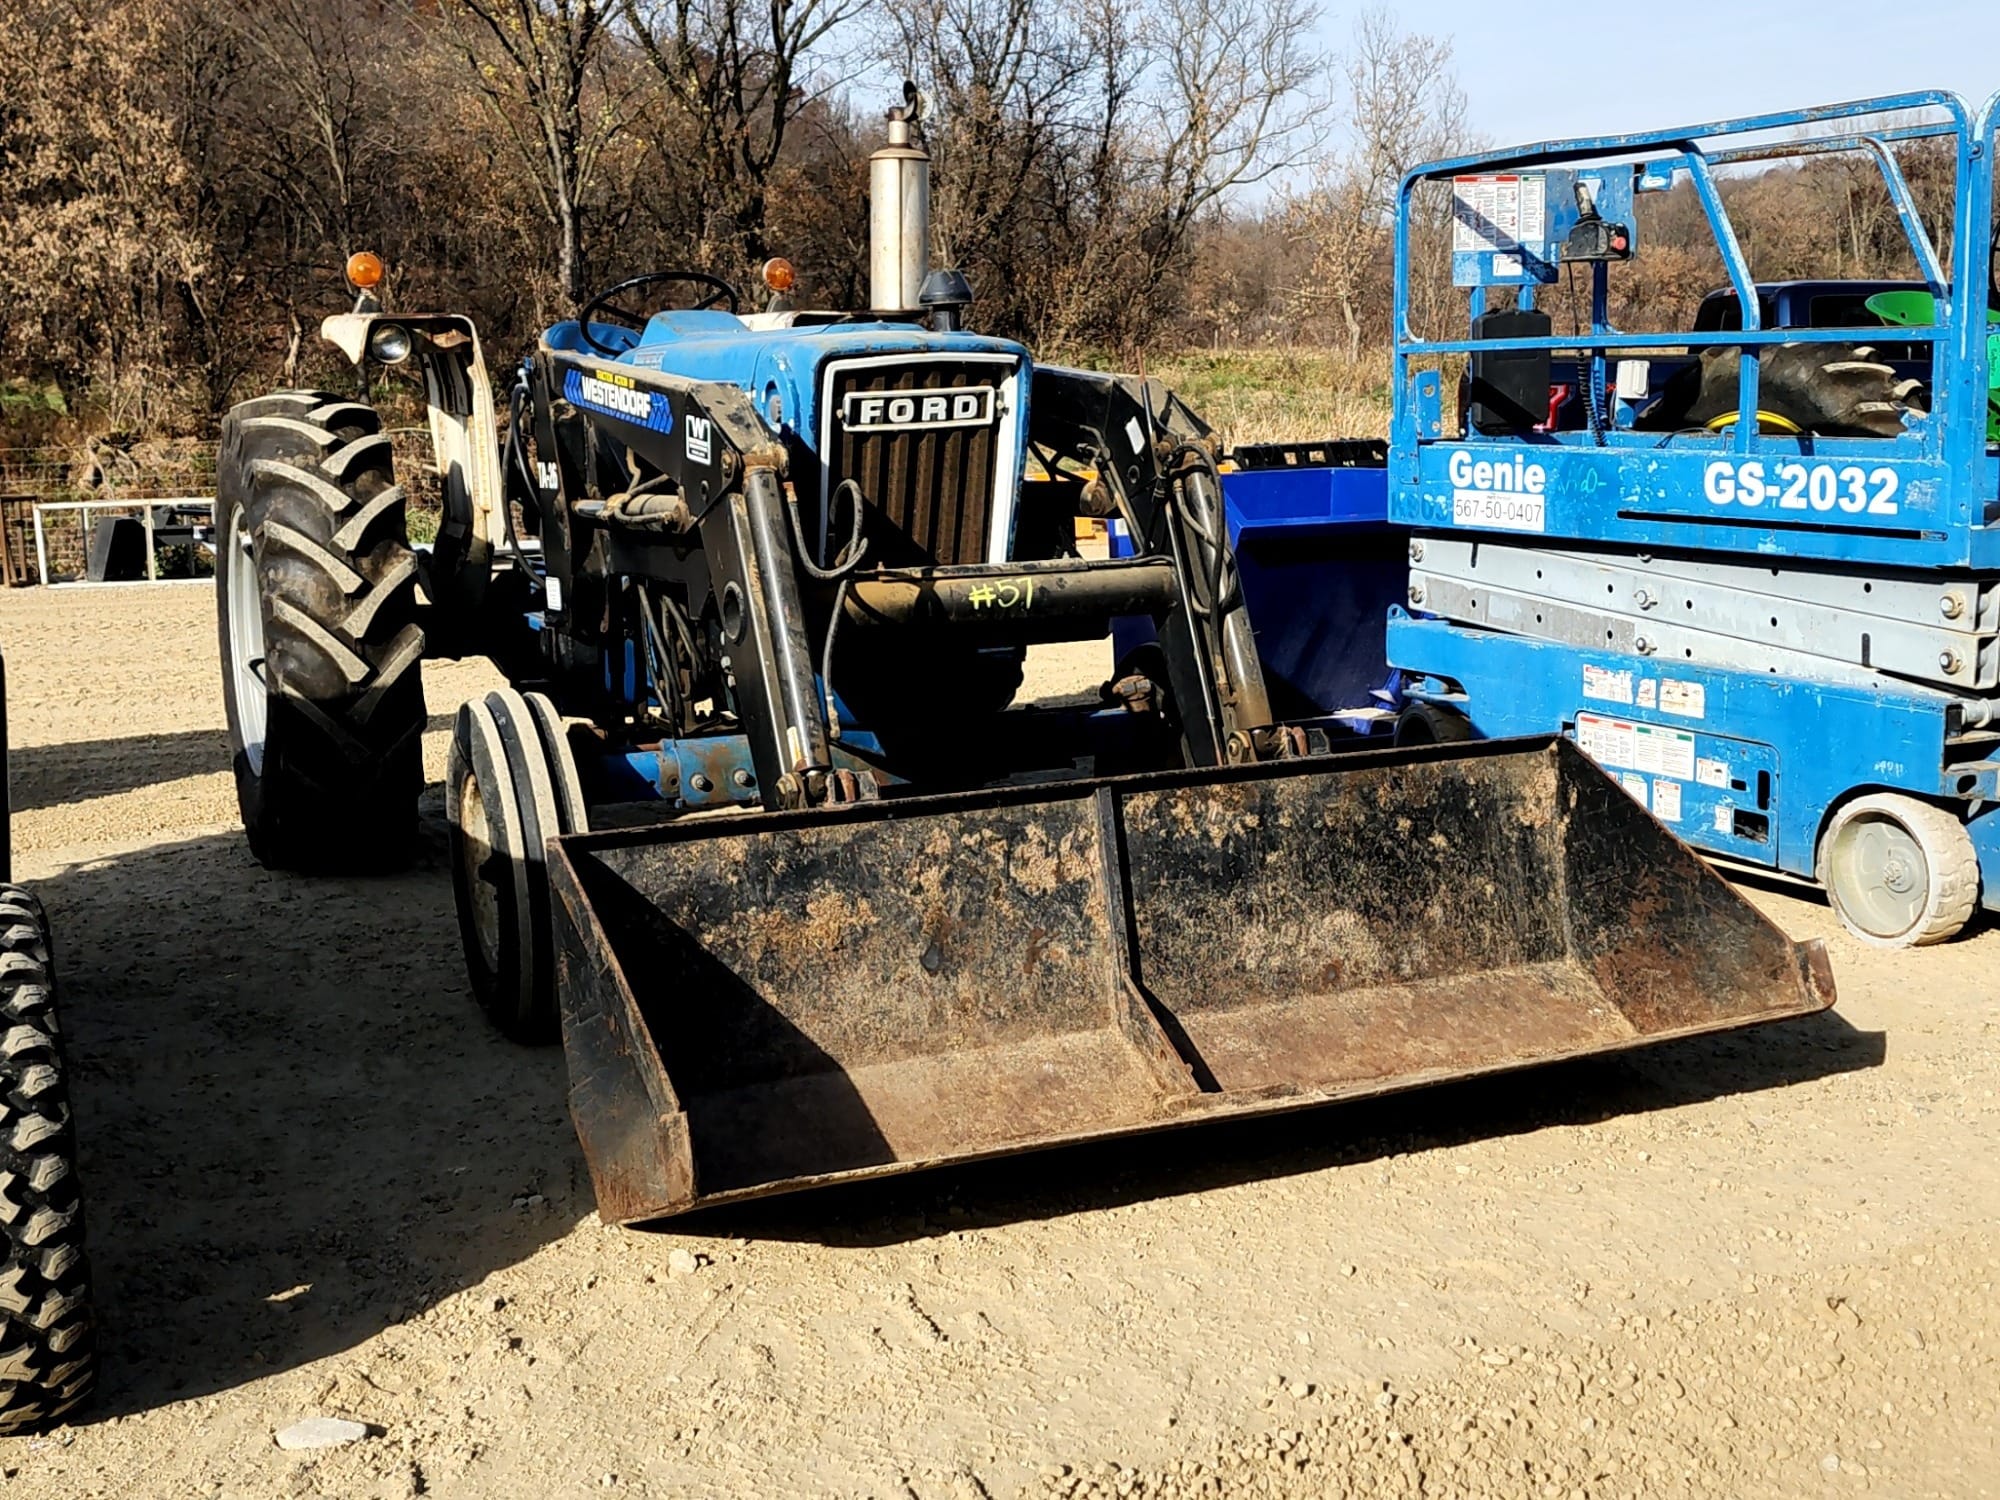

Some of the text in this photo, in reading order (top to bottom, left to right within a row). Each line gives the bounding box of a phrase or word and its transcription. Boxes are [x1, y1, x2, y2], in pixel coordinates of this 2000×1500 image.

[581, 376, 651, 418] WESTENDORF
[860, 395, 978, 424] FORD
[1449, 450, 1546, 494] Genie
[1704, 461, 1899, 515] GS-2032
[1455, 499, 1542, 523] 567-50-0407
[968, 577, 1033, 610] #57
